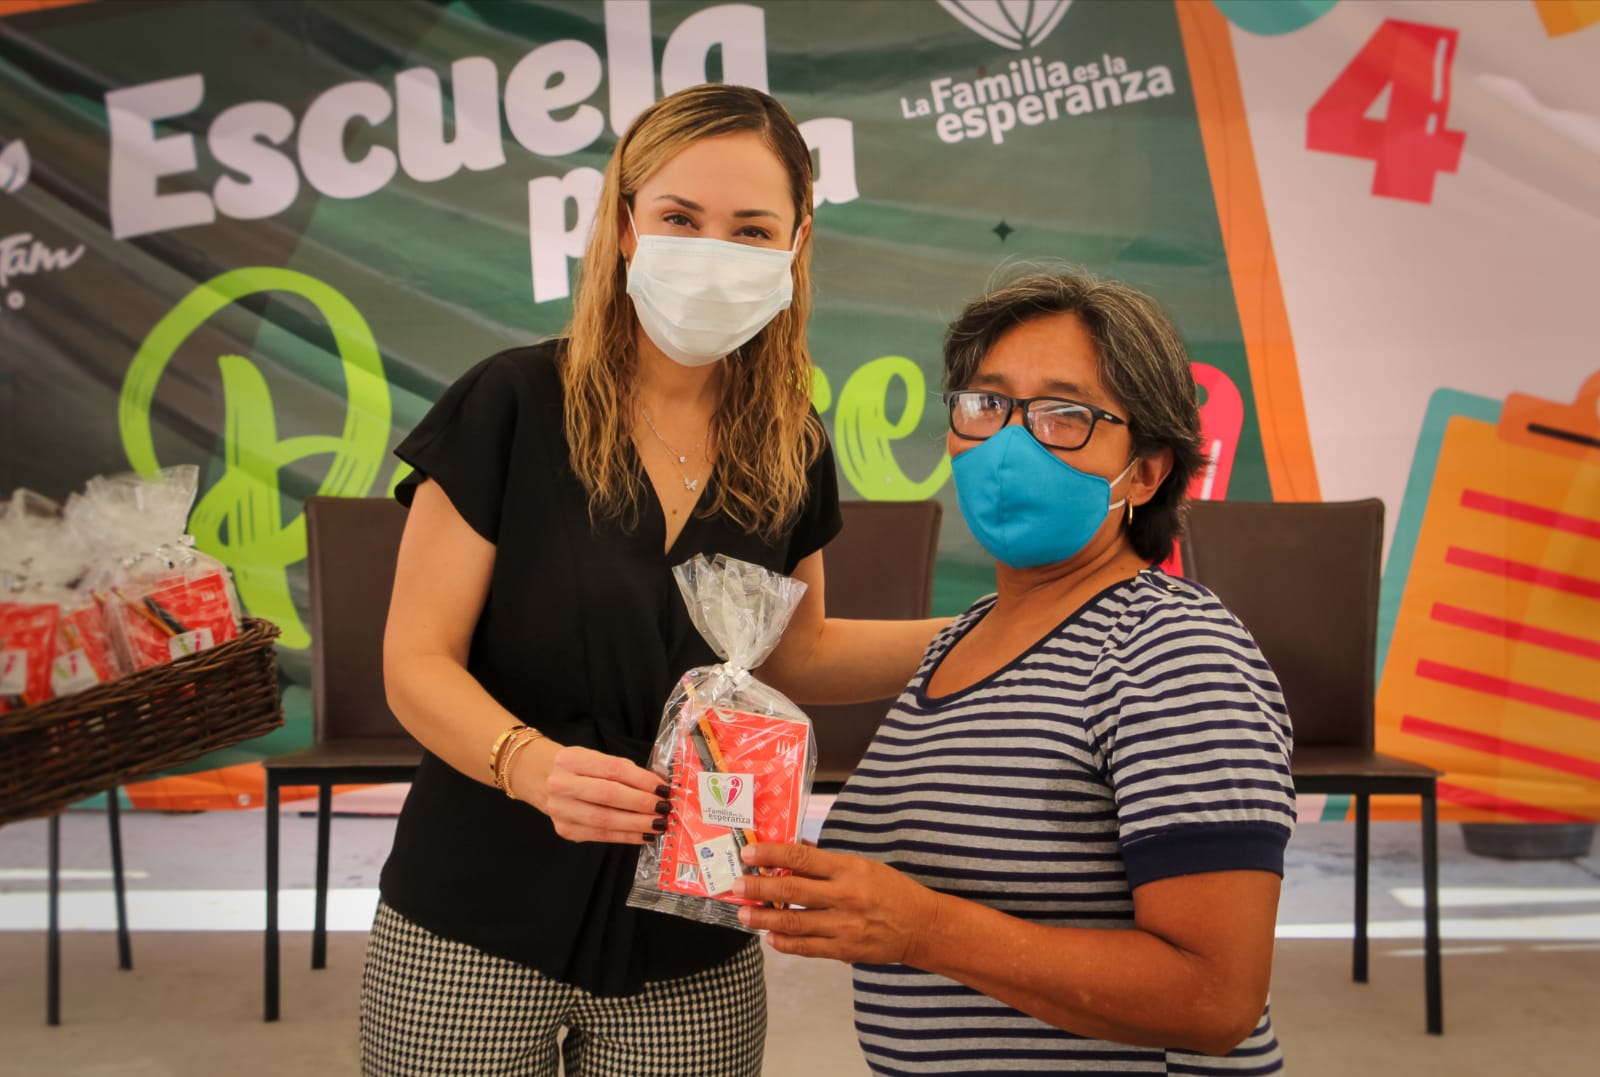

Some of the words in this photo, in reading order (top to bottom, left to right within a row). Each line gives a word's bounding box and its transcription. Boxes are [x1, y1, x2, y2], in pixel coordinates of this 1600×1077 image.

[105, 0, 769, 239] Escuela
[900, 97, 931, 119] La
[930, 56, 1070, 113] Familia
[1072, 62, 1100, 83] es
[1103, 53, 1127, 76] la
[936, 65, 1175, 144] esperanza
[1306, 18, 1467, 205] 4
